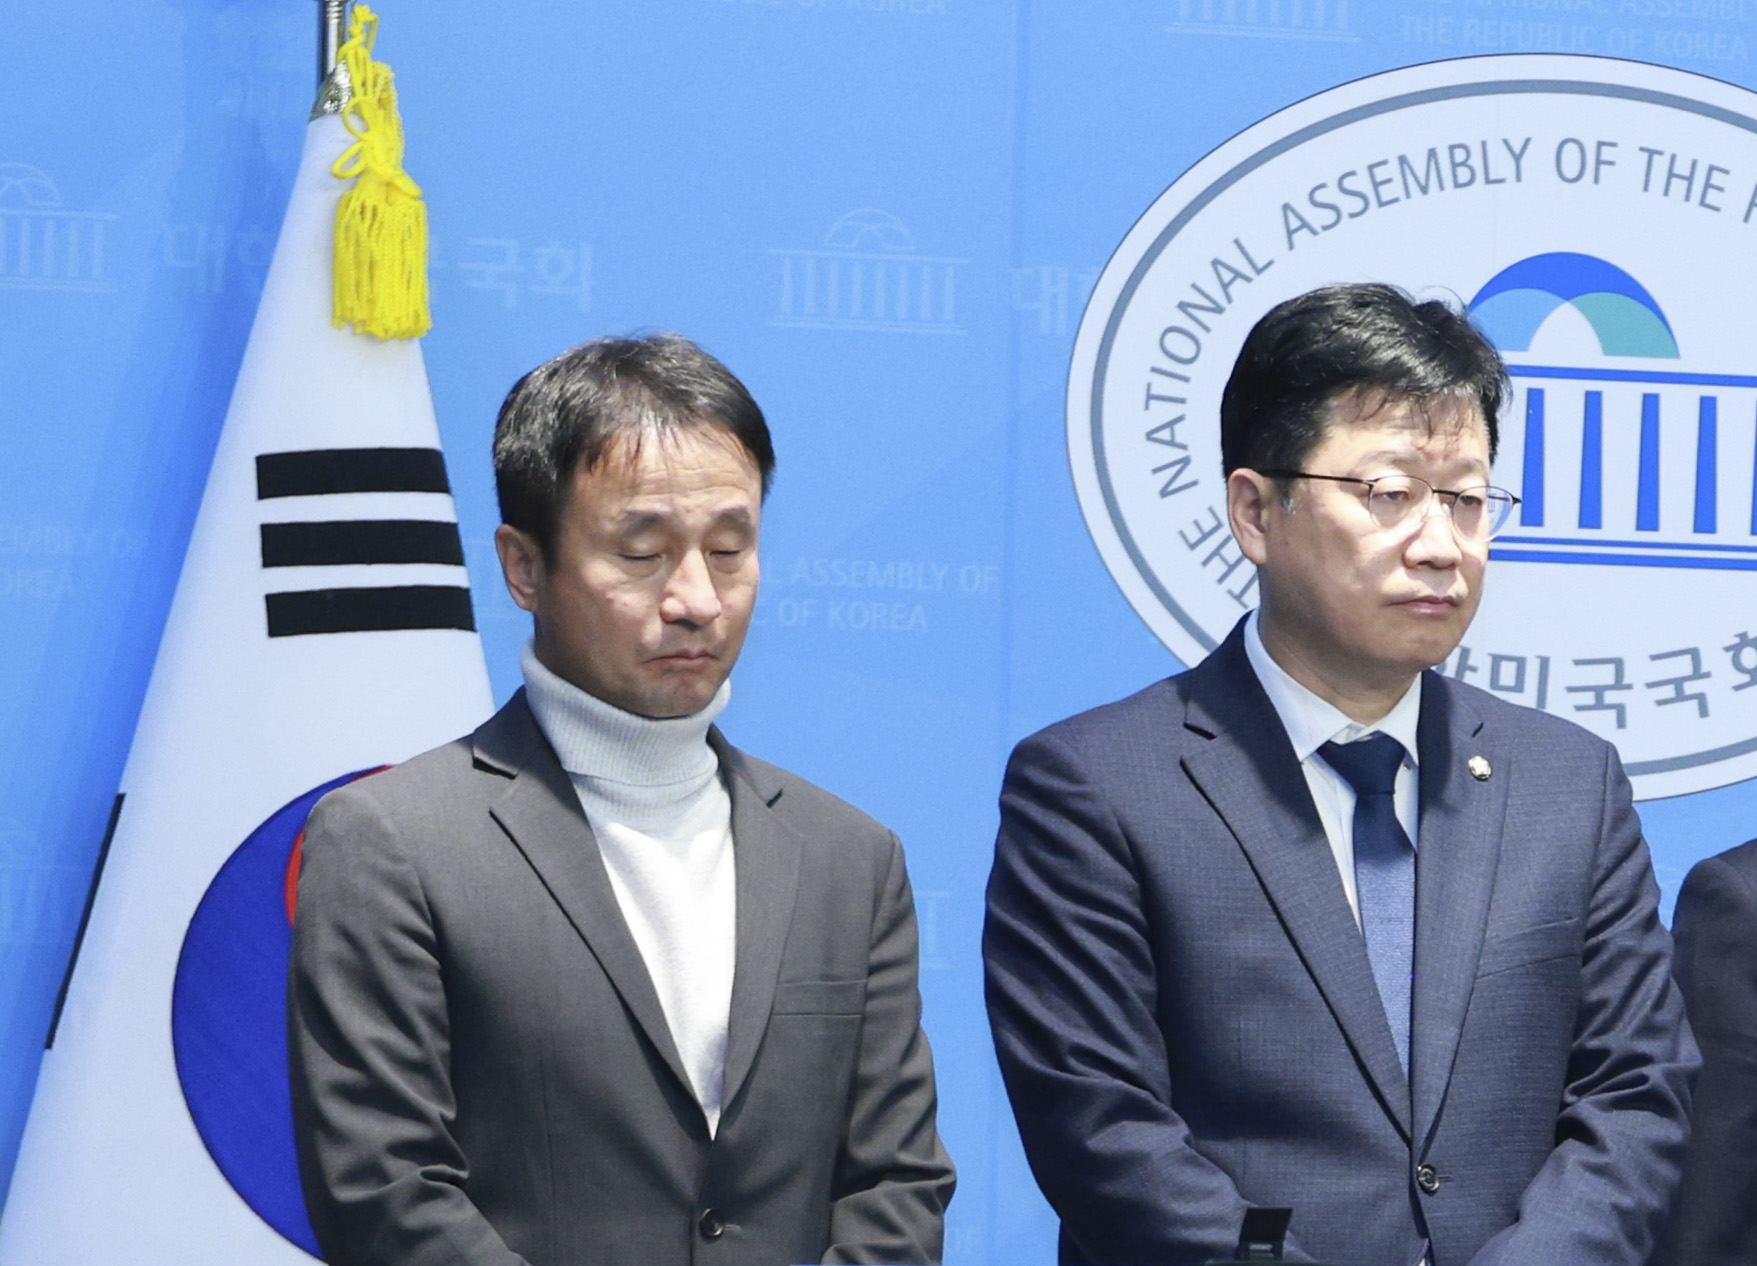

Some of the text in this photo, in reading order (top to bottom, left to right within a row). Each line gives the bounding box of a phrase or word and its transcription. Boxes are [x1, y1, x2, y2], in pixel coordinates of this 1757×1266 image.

[1402, 15, 1749, 62] THE REPUBLIC OF KOREA
[1144, 237, 1275, 500] NATIONAL
[1281, 136, 1532, 250] ASSEMBLY
[1554, 136, 1622, 185] OF
[1640, 146, 1732, 214] THE
[789, 557, 950, 592] ASSEMBLY
[958, 562, 1000, 595] OF
[776, 597, 929, 632] OF KOREA
